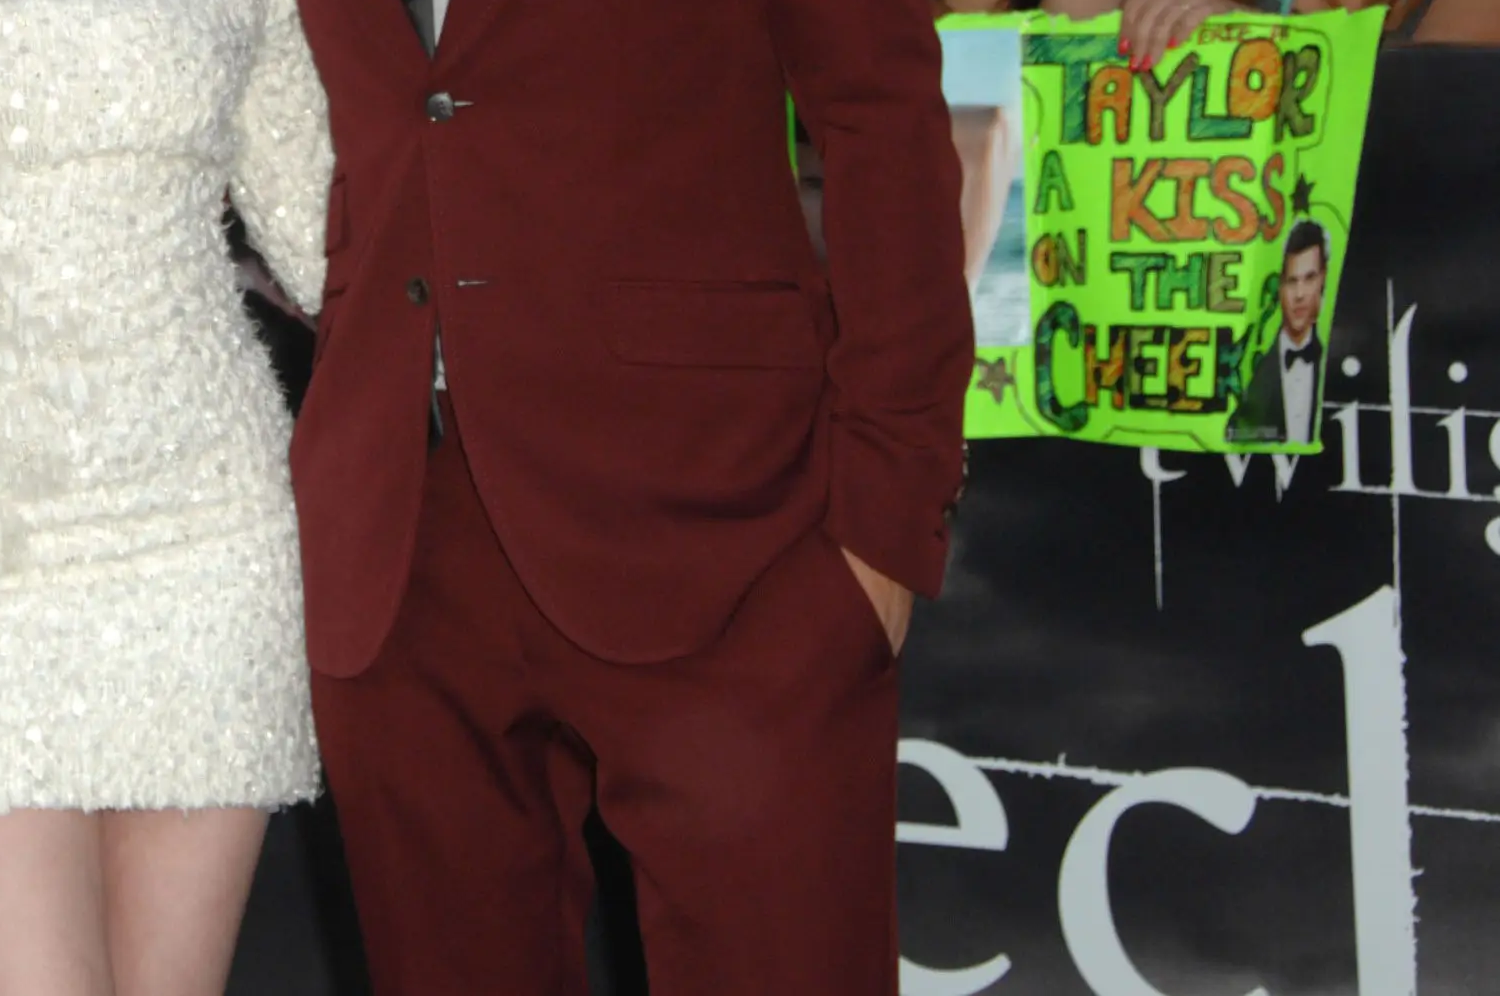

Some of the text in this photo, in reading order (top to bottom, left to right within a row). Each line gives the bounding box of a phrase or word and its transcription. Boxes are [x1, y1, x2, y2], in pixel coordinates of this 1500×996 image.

[1023, 33, 1322, 145] TAYLOR
[1033, 150, 1285, 245] A KISS
[1031, 229, 1247, 314] ON THE
